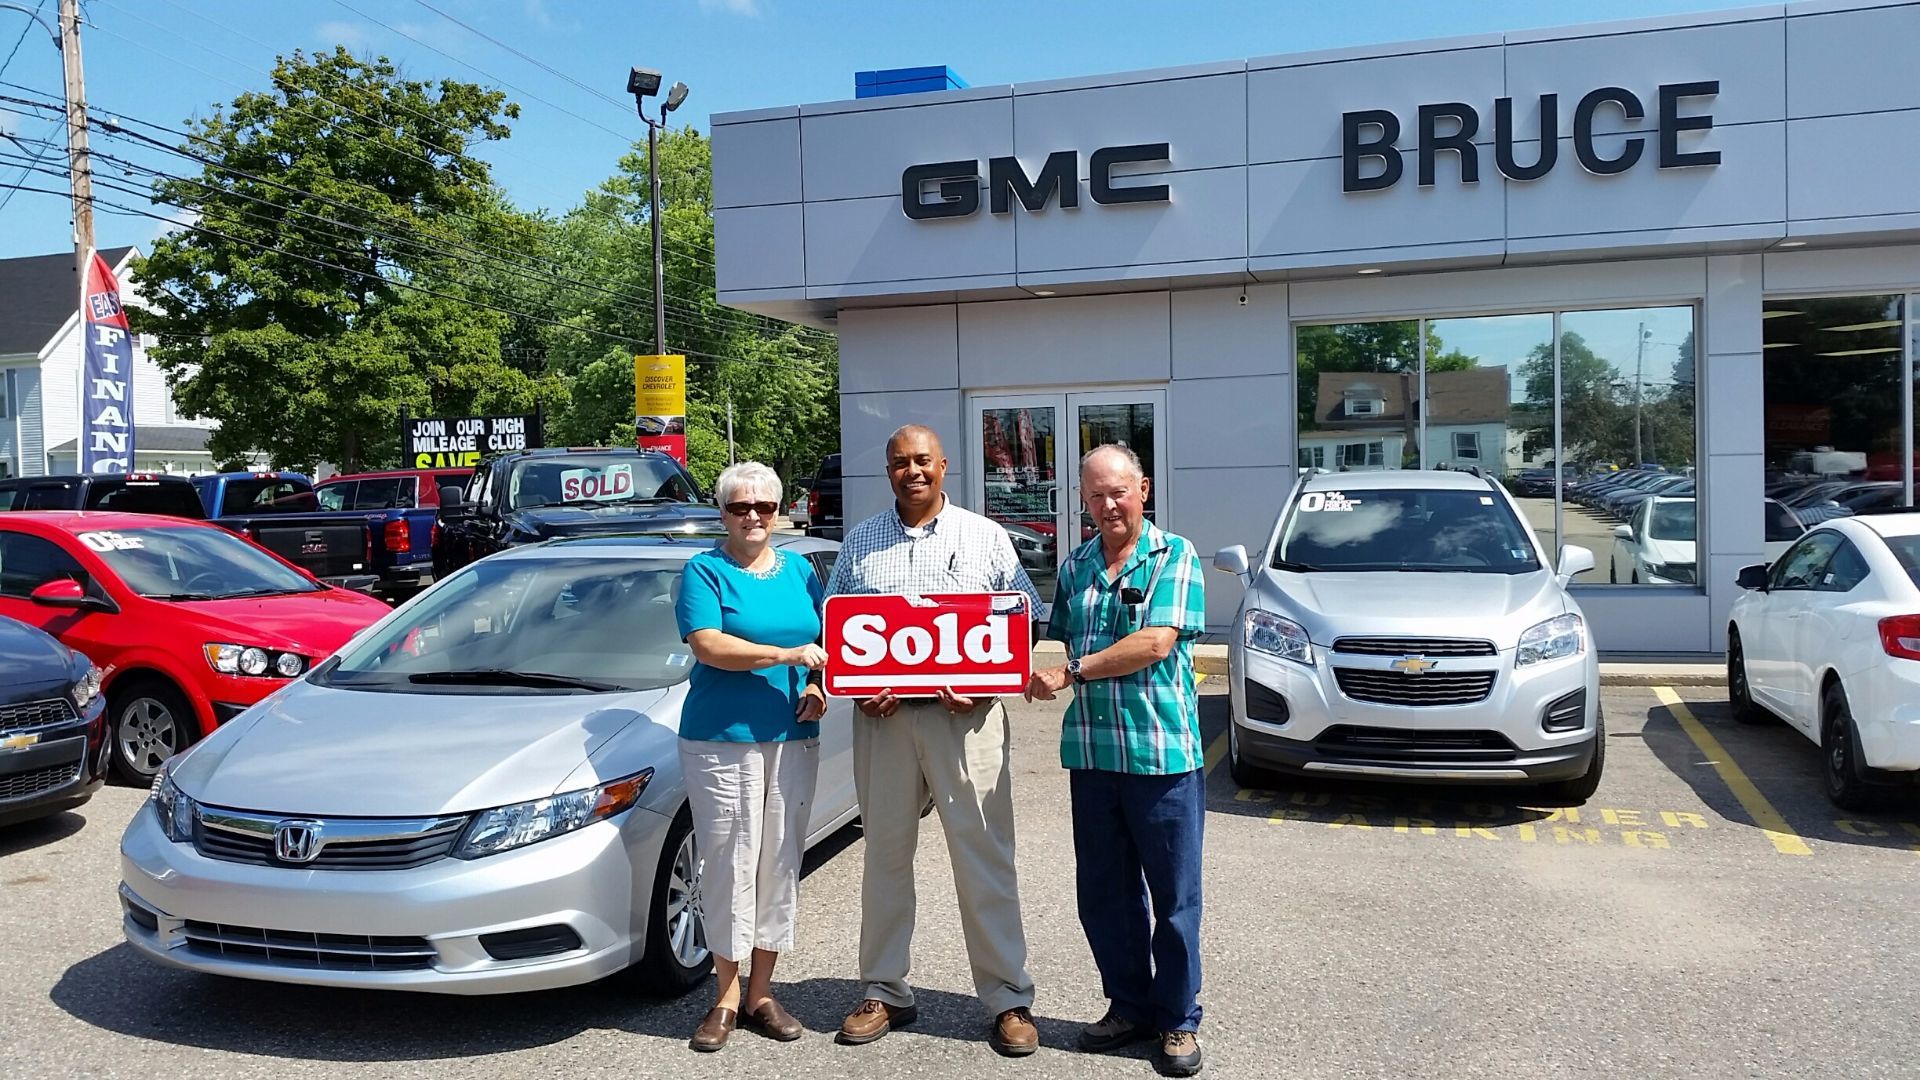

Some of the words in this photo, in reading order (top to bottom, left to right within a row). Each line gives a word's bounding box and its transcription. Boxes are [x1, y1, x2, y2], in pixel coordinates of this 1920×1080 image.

[1341, 80, 1722, 194] BRUCE
[900, 143, 1171, 220] GMC
[89, 291, 121, 320] EAS
[644, 375, 674, 383] DISCOVER
[412, 420, 446, 437] JOIN
[456, 419, 485, 435] OUR
[491, 417, 525, 434] HIGH
[413, 435, 477, 453] MILEAGE
[488, 434, 526, 450] CLUB
[416, 452, 481, 469] SAVE
[564, 472, 631, 500] SOLD
[841, 613, 1014, 666] Sold
[1268, 809, 1671, 849] PARKING
